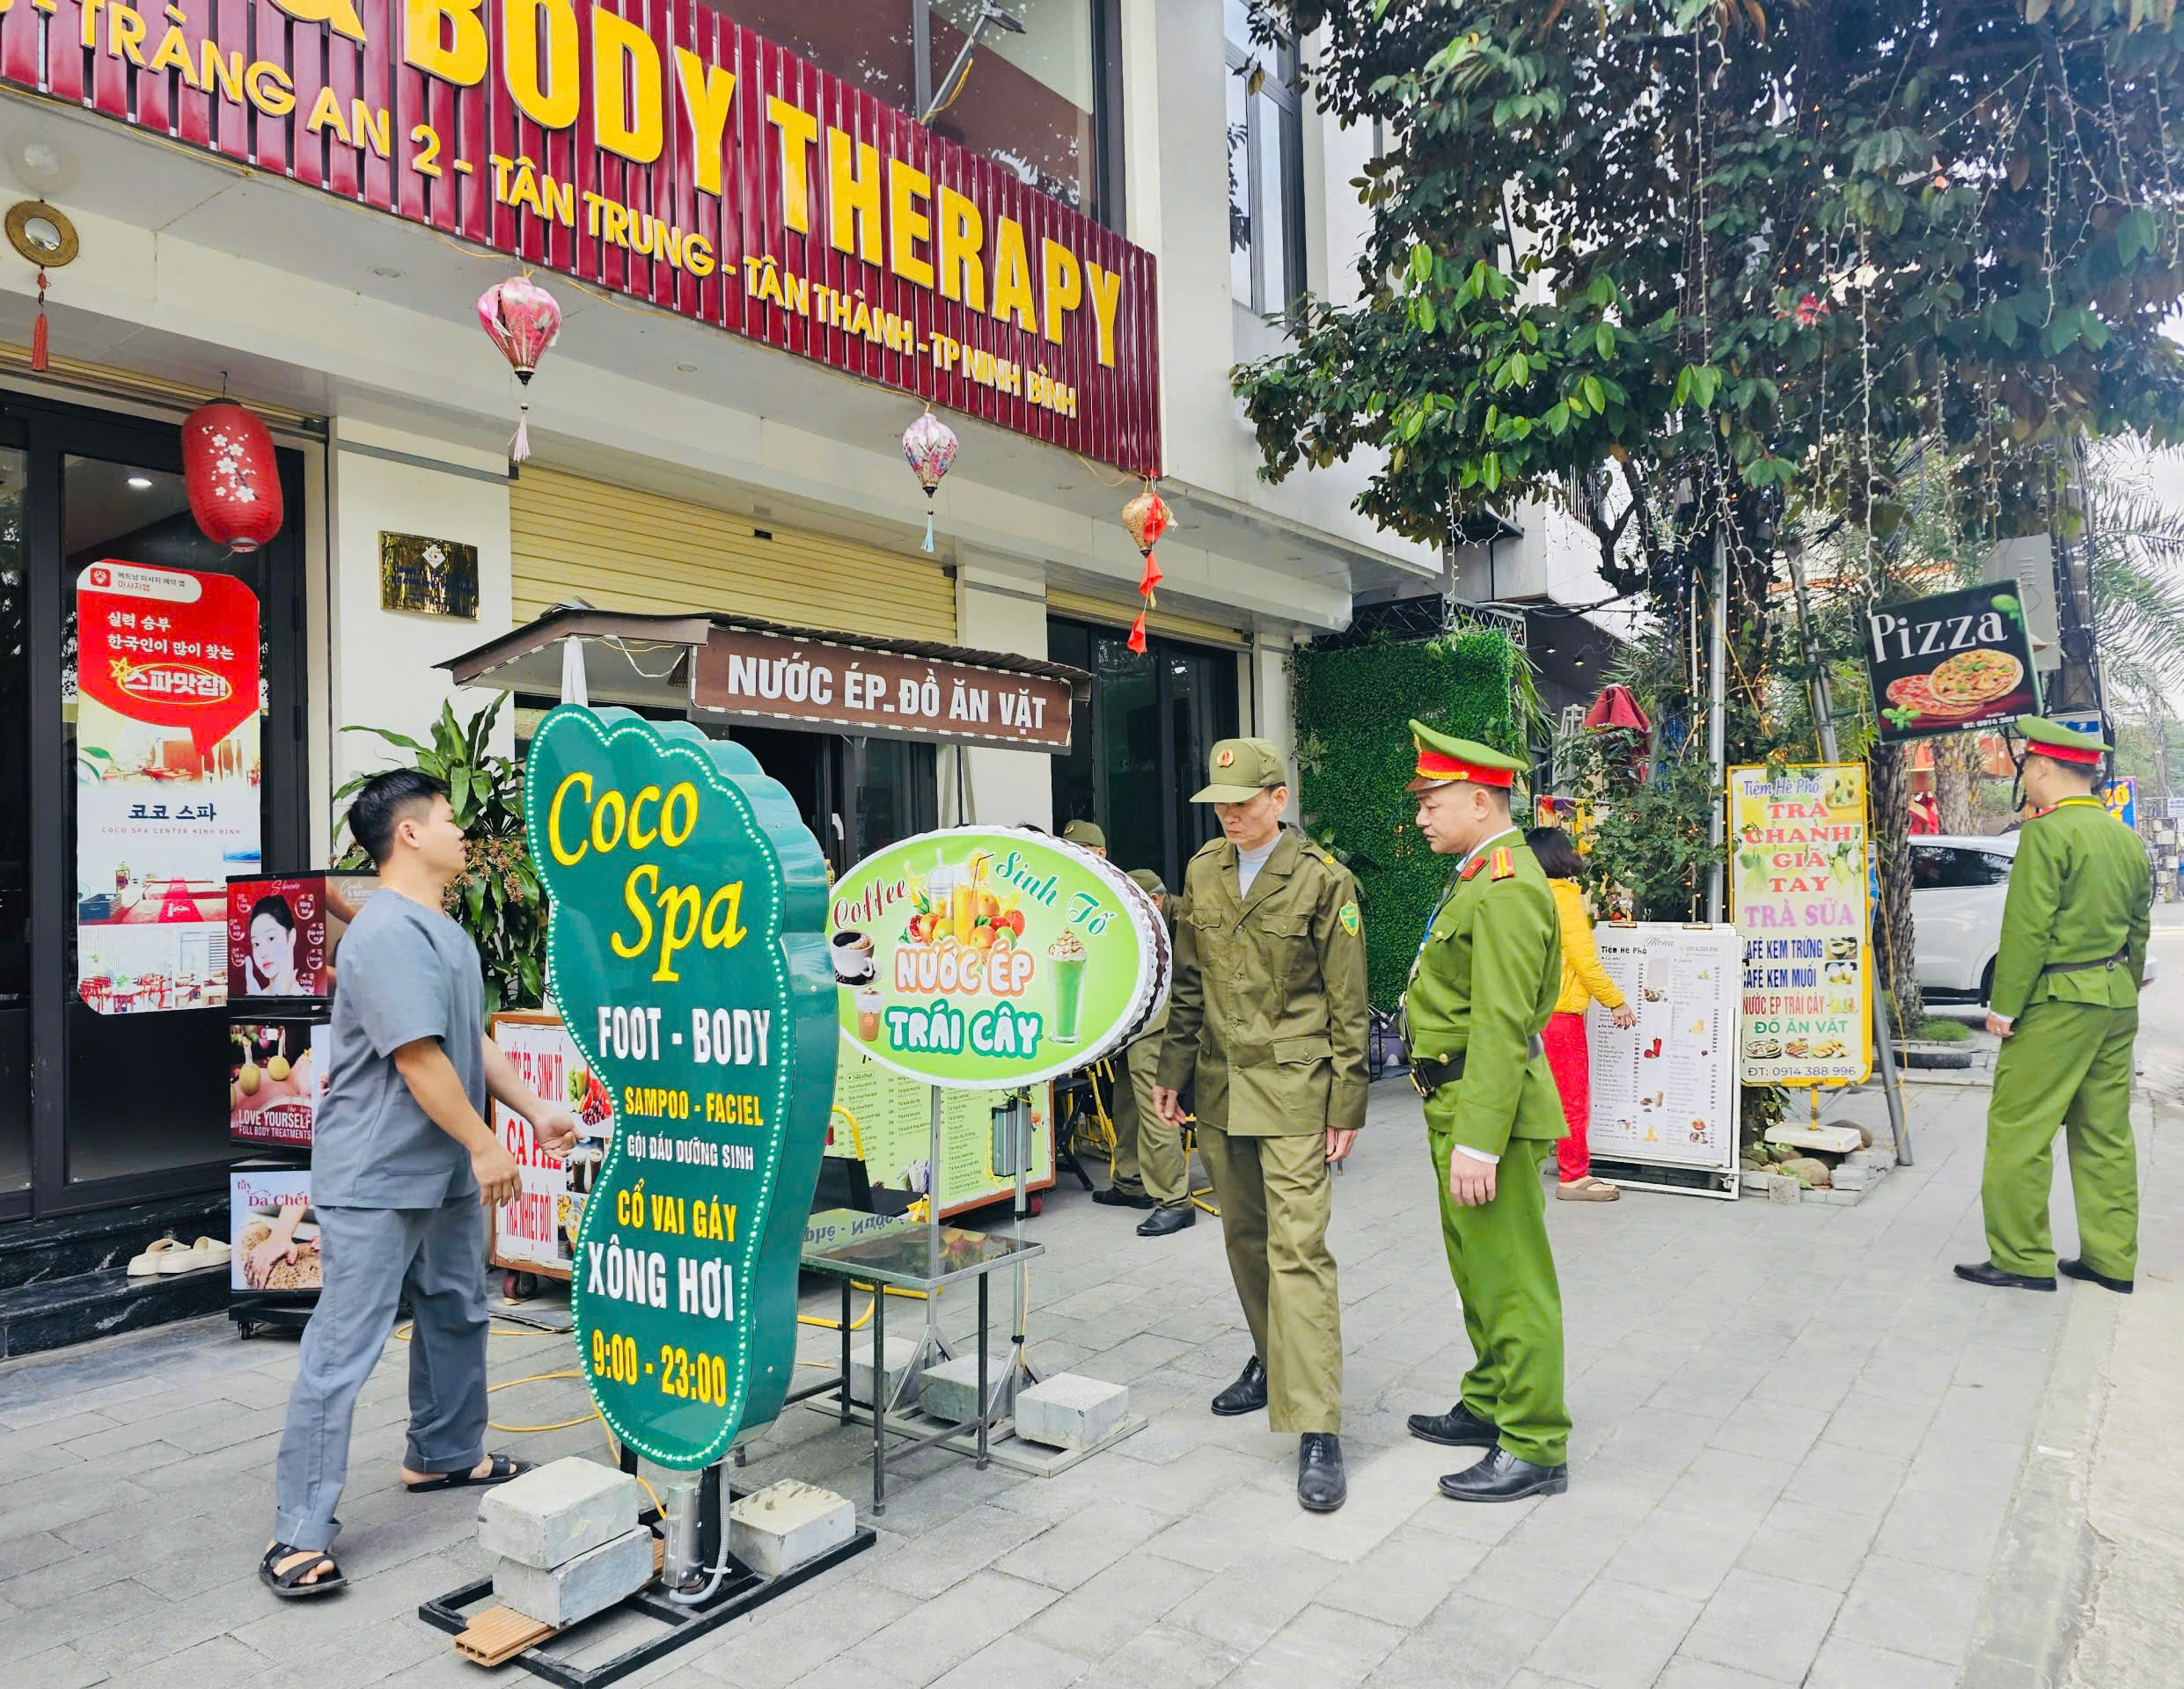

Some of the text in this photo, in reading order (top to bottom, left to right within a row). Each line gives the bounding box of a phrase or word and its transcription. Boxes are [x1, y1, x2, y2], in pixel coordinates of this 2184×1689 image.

[71, 0, 296, 117] TRÀNG
[307, 86, 391, 158] AN
[411, 124, 442, 178] 2
[454, 159, 473, 174] -
[489, 153, 575, 228] TÂN
[583, 190, 715, 277] TRUNG
[744, 254, 809, 317] TÂN
[813, 283, 913, 355] THÀNH
[929, 331, 960, 372] TP
[963, 345, 1022, 397] NINH
[1028, 367, 1077, 418] BÌNH
[766, 94, 1121, 369] THERAPY
[106, 612, 171, 632] 실력 승부
[1871, 611, 2007, 663] Pizza
[106, 634, 235, 661] 한국인이 많이 찾는
[125, 669, 226, 697] 스파맛집!
[728, 652, 832, 705] NƯỚC
[949, 679, 989, 723] ĂN
[999, 688, 1046, 735] VẶT
[1743, 780, 1772, 799] Tiệm
[1796, 776, 1822, 793] Phố
[128, 802, 216, 822] 코코 스파
[548, 771, 699, 866] Coco
[1768, 798, 1829, 819] TRÀ
[1745, 826, 1851, 844] CHANH
[995, 851, 1116, 936] Sinh Tố
[1769, 876, 1829, 893] TAY
[833, 879, 909, 930] Coffee
[1745, 896, 1856, 927] TRÀ SỮA
[611, 864, 748, 983] Spa
[1766, 940, 1788, 959] KEM
[1792, 936, 1822, 959] TRỨNG
[896, 937, 1034, 996] NƯỚC ÉP
[1767, 969, 1788, 988] KEM
[1792, 962, 1816, 987] MUỐI
[1770, 992, 1781, 1014] ÉP
[1785, 992, 1804, 1013] TRÁI
[1807, 992, 1824, 1013] CÂY
[597, 1005, 662, 1061] FOOT
[692, 1008, 771, 1066] BODY
[885, 999, 1042, 1058] TRÁI CÂY
[1755, 1017, 1780, 1034] ĐỒ
[1786, 1018, 1809, 1034] ĂN
[538, 1053, 553, 1100] SINH
[1748, 1066, 1856, 1077] ĐT: 0914 388 996
[238, 1109, 311, 1129] LOVE YOURSELF
[624, 1086, 689, 1120] SAMPOO
[706, 1092, 764, 1127] FACIEL
[239, 1125, 311, 1140] FULL BODY TREATMENTS
[722, 1144, 754, 1171] SINH
[618, 1178, 737, 1243] CỔ VAI GÁY
[586, 1234, 734, 1321] XÔNG HƠI
[591, 1329, 638, 1386] 9:00
[661, 1344, 727, 1408] 23:00
